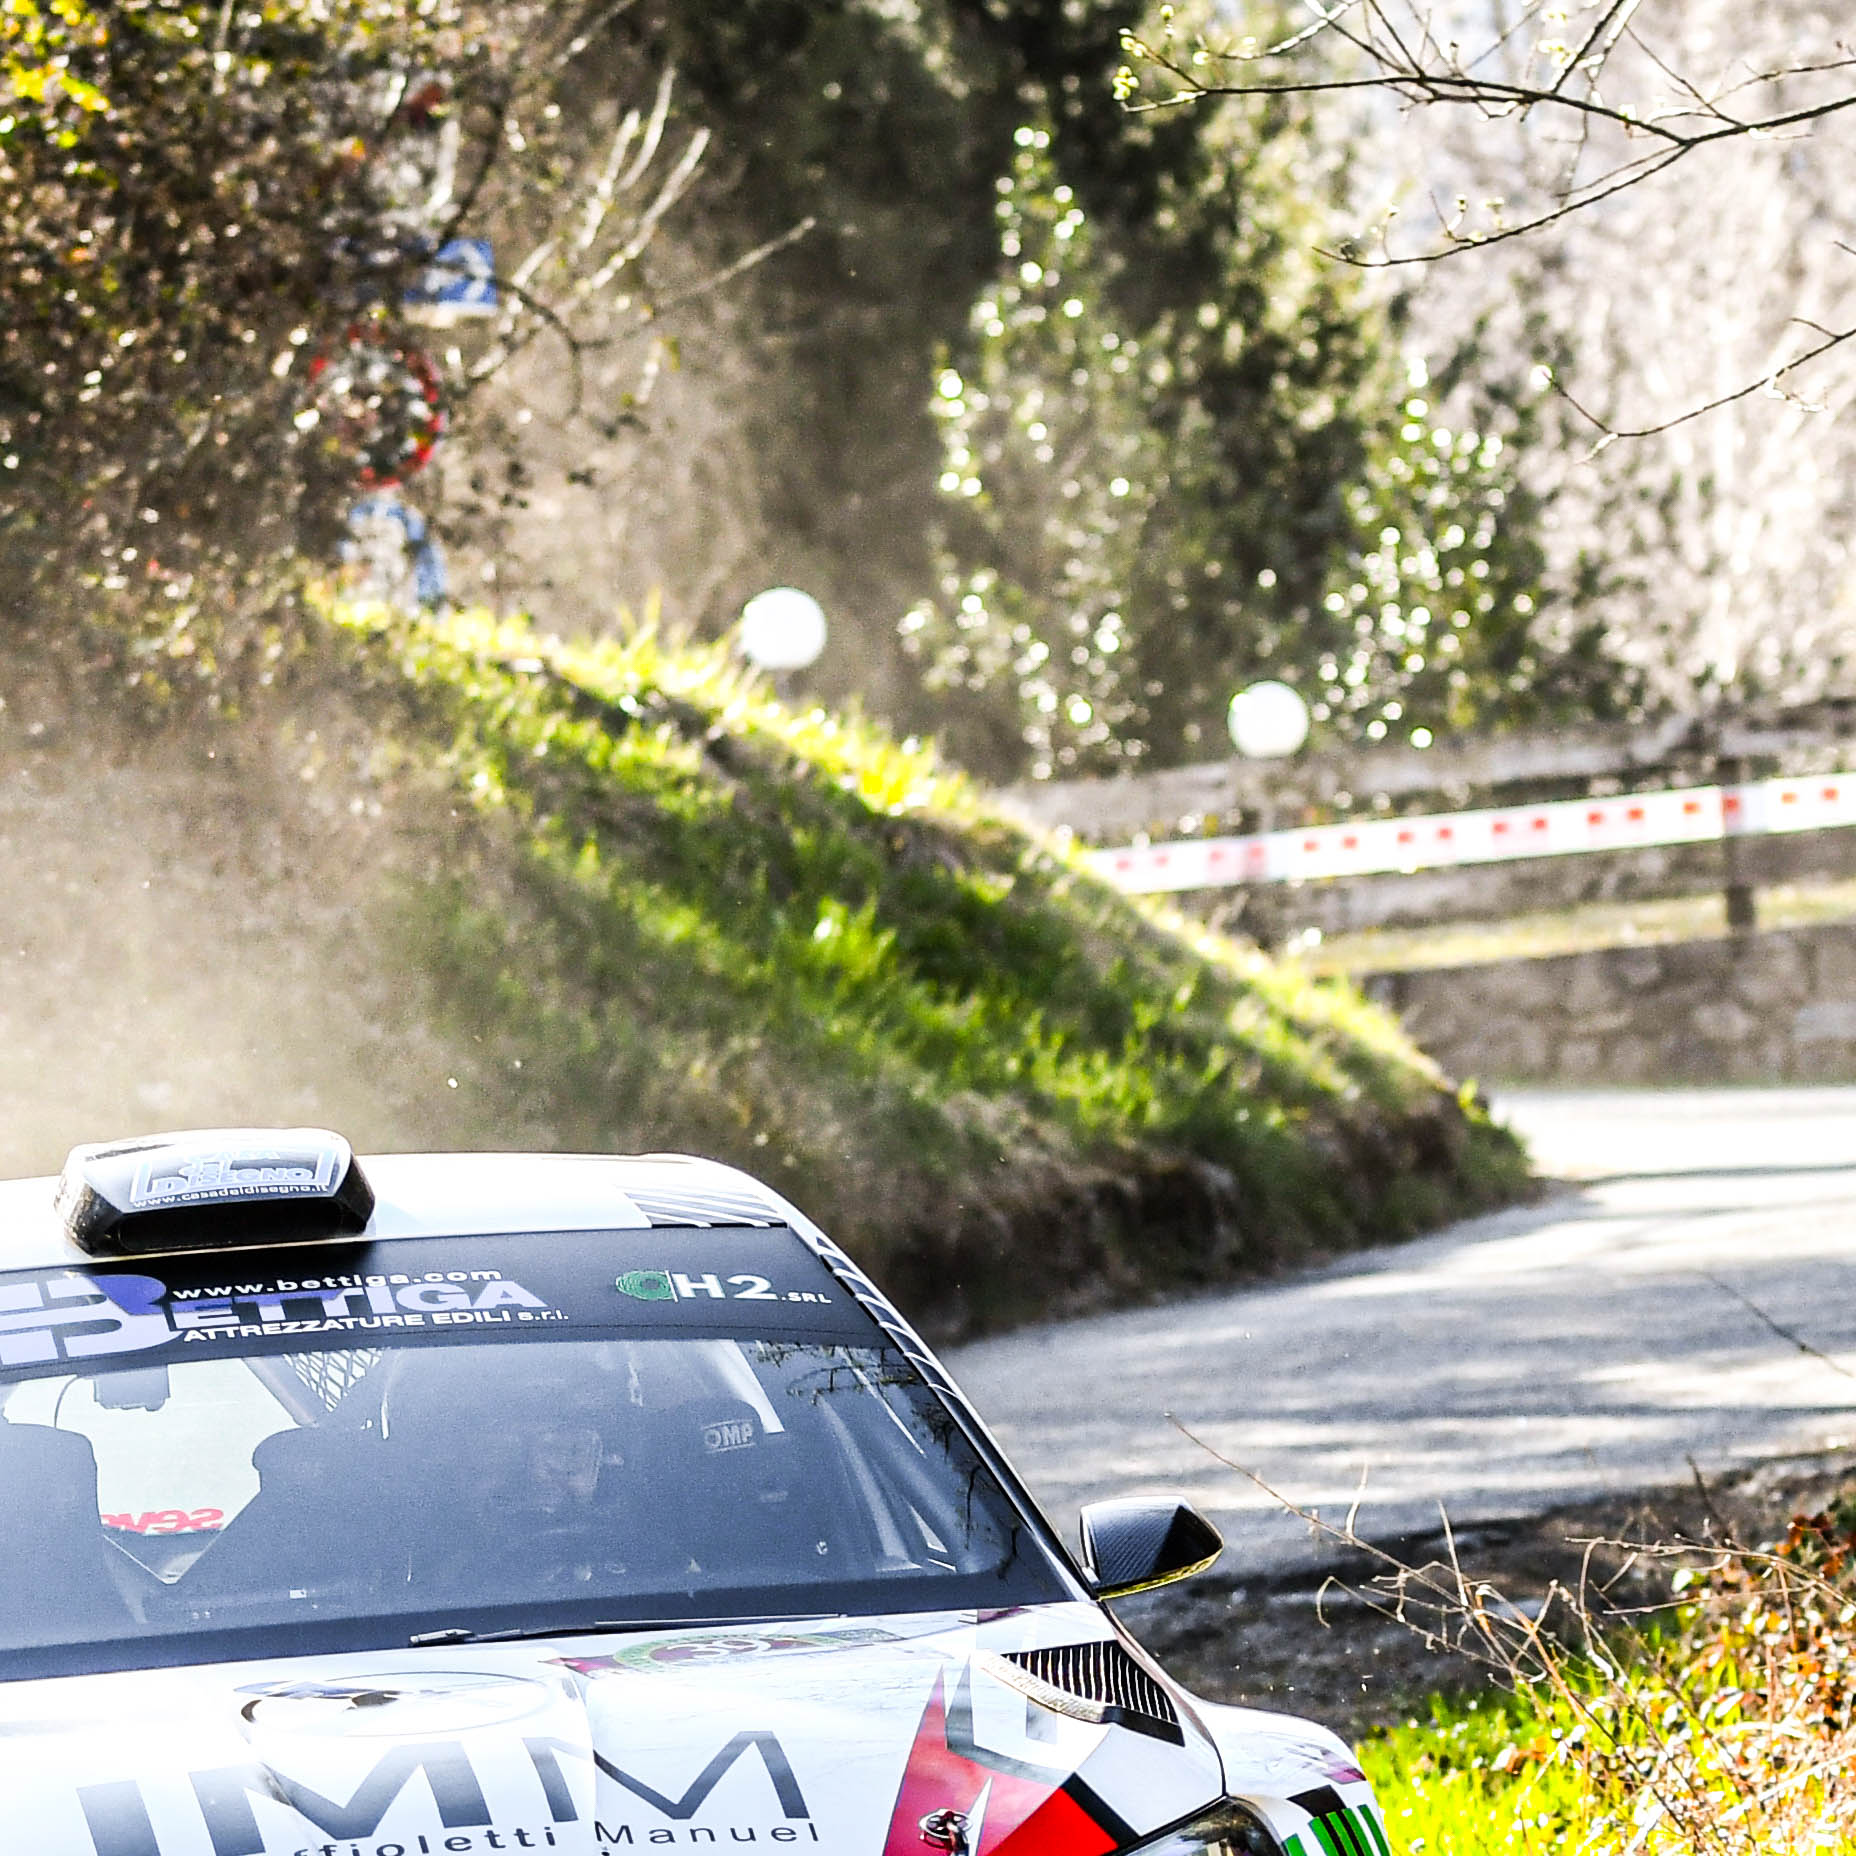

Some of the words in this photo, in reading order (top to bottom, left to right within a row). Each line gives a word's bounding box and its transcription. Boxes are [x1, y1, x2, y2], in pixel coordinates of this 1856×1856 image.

[132, 1184, 329, 1208] www.casadeldisegno.it
[172, 1269, 502, 1300] www.bettiga.com
[183, 1312, 426, 1342] ATTREZZATURE
[431, 1310, 511, 1325] EDILI
[517, 1309, 569, 1322] s.r.l.
[704, 1421, 755, 1449] OMP
[594, 1820, 820, 1846] Manuel
